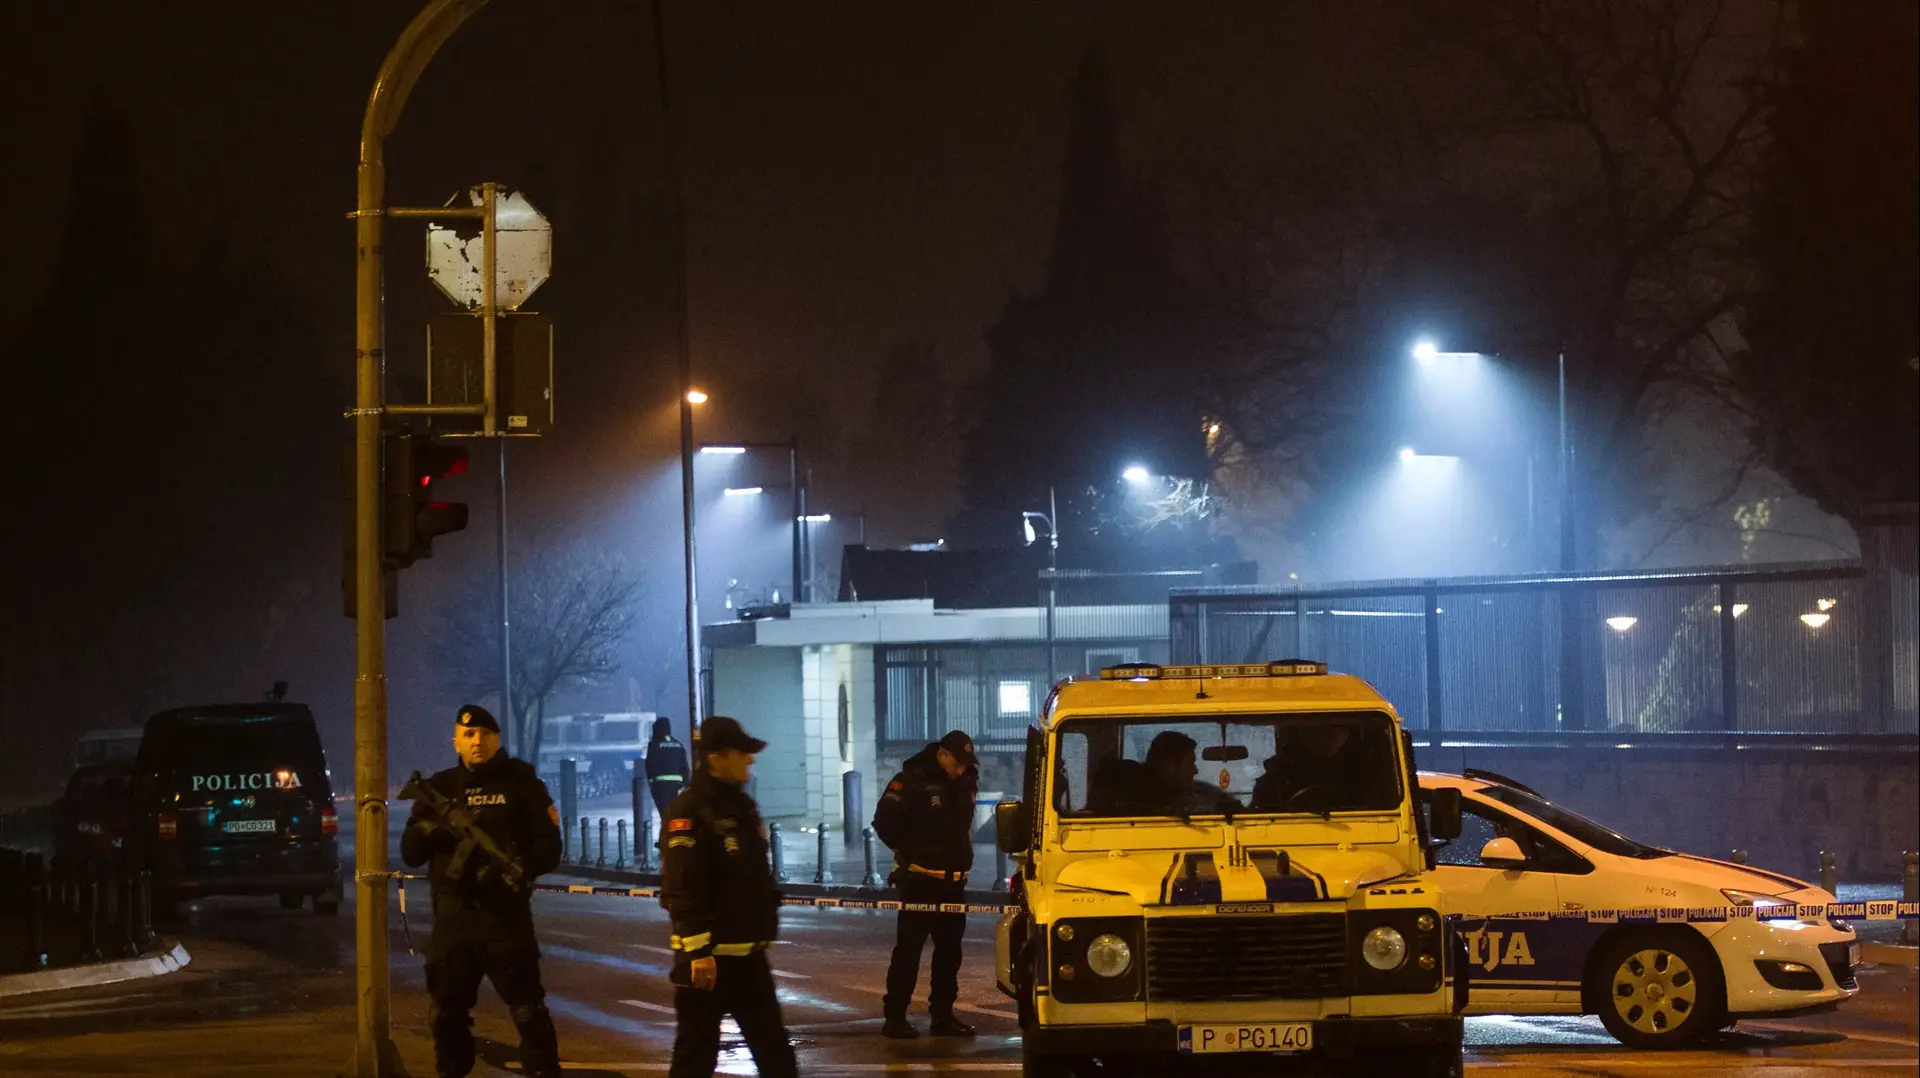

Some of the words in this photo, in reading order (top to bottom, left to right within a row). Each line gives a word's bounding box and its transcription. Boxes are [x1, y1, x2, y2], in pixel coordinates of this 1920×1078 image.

[192, 772, 302, 791] POLICIJA
[467, 793, 506, 806] ICIJA
[1660, 887, 1677, 897] 124
[905, 903, 936, 912] POLICIJA
[1219, 905, 1270, 913] DEFENDER
[1590, 910, 1615, 919] STOP
[1660, 909, 1683, 918] STOP
[1688, 908, 1725, 918] POLICIJA
[1730, 907, 1753, 918] STOP
[1758, 905, 1795, 917] POLICIJA
[1800, 905, 1823, 916] STOP
[1828, 903, 1865, 916] POLICIJA
[1869, 903, 1893, 915] STOP
[1456, 931, 1535, 972] IJA
[1203, 1029, 1215, 1049] P
[1238, 1027, 1308, 1049] PG140
